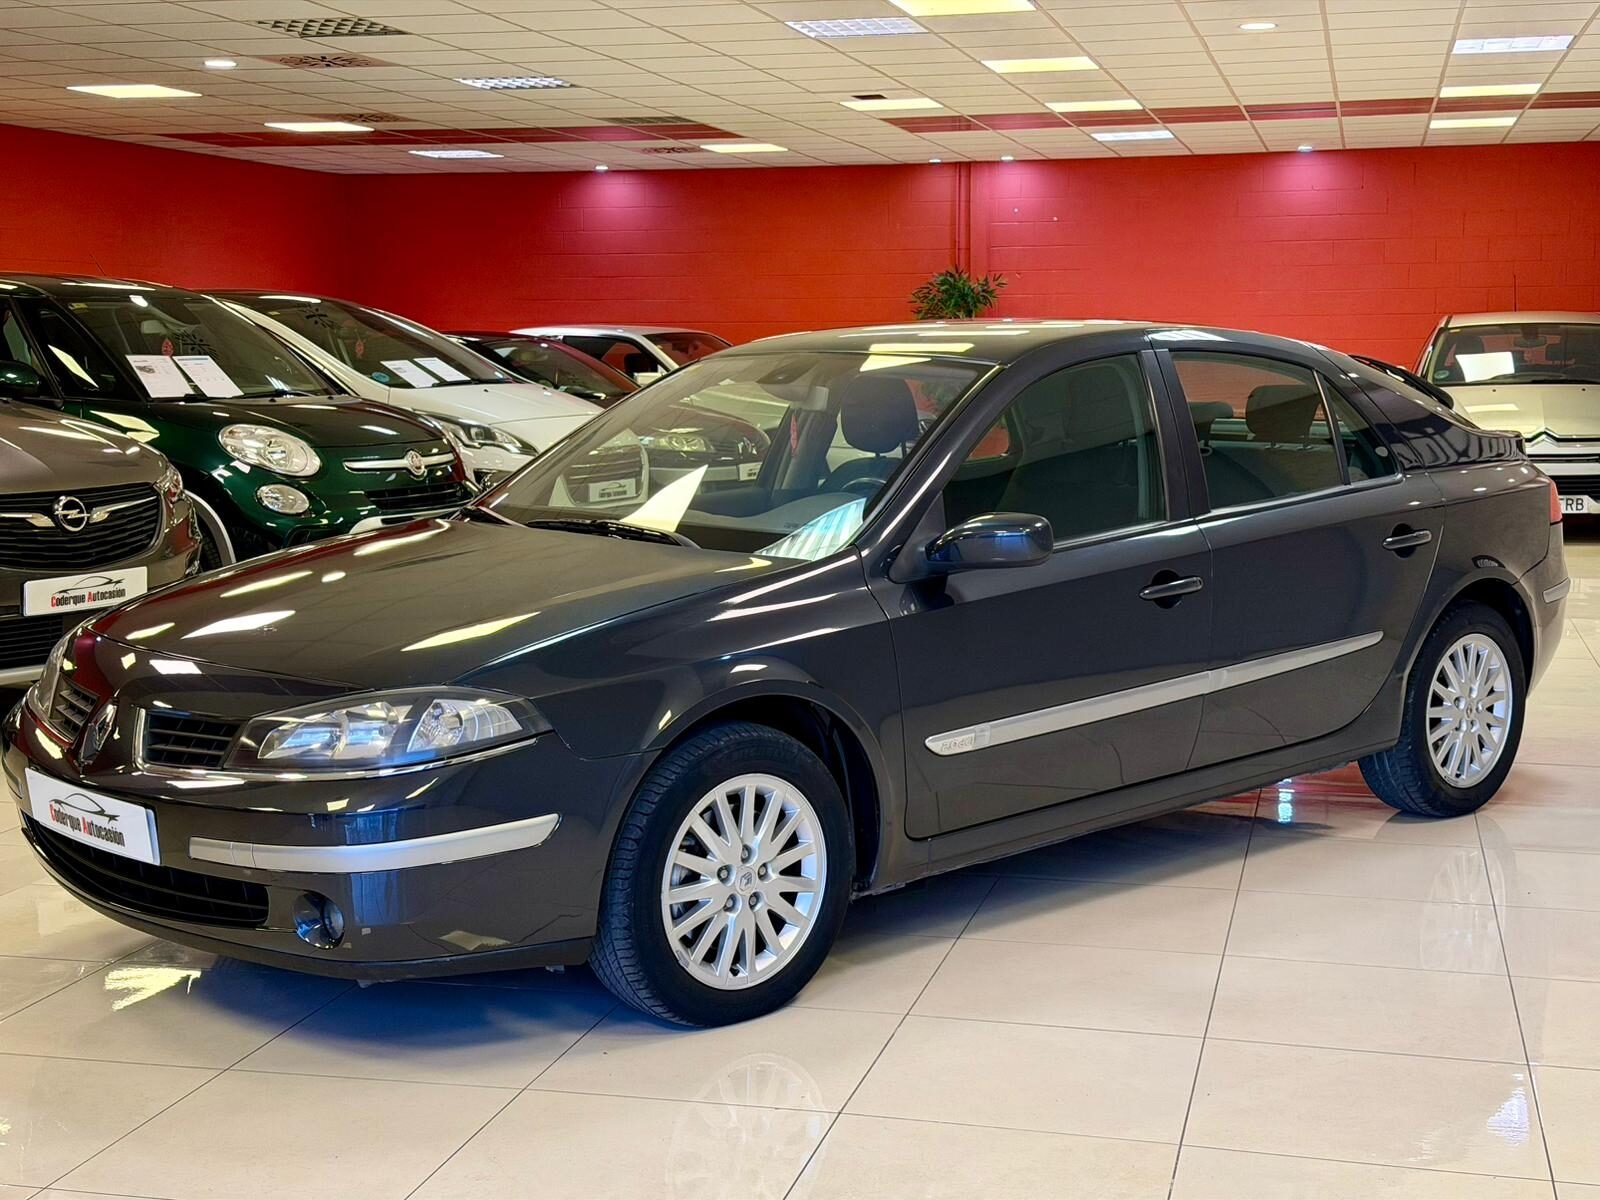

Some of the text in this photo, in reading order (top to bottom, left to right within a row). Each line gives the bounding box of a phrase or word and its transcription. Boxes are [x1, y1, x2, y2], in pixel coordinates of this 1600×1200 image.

[1559, 497, 1584, 511] RB
[51, 594, 85, 607] Coderque
[49, 804, 81, 832] Coderque
